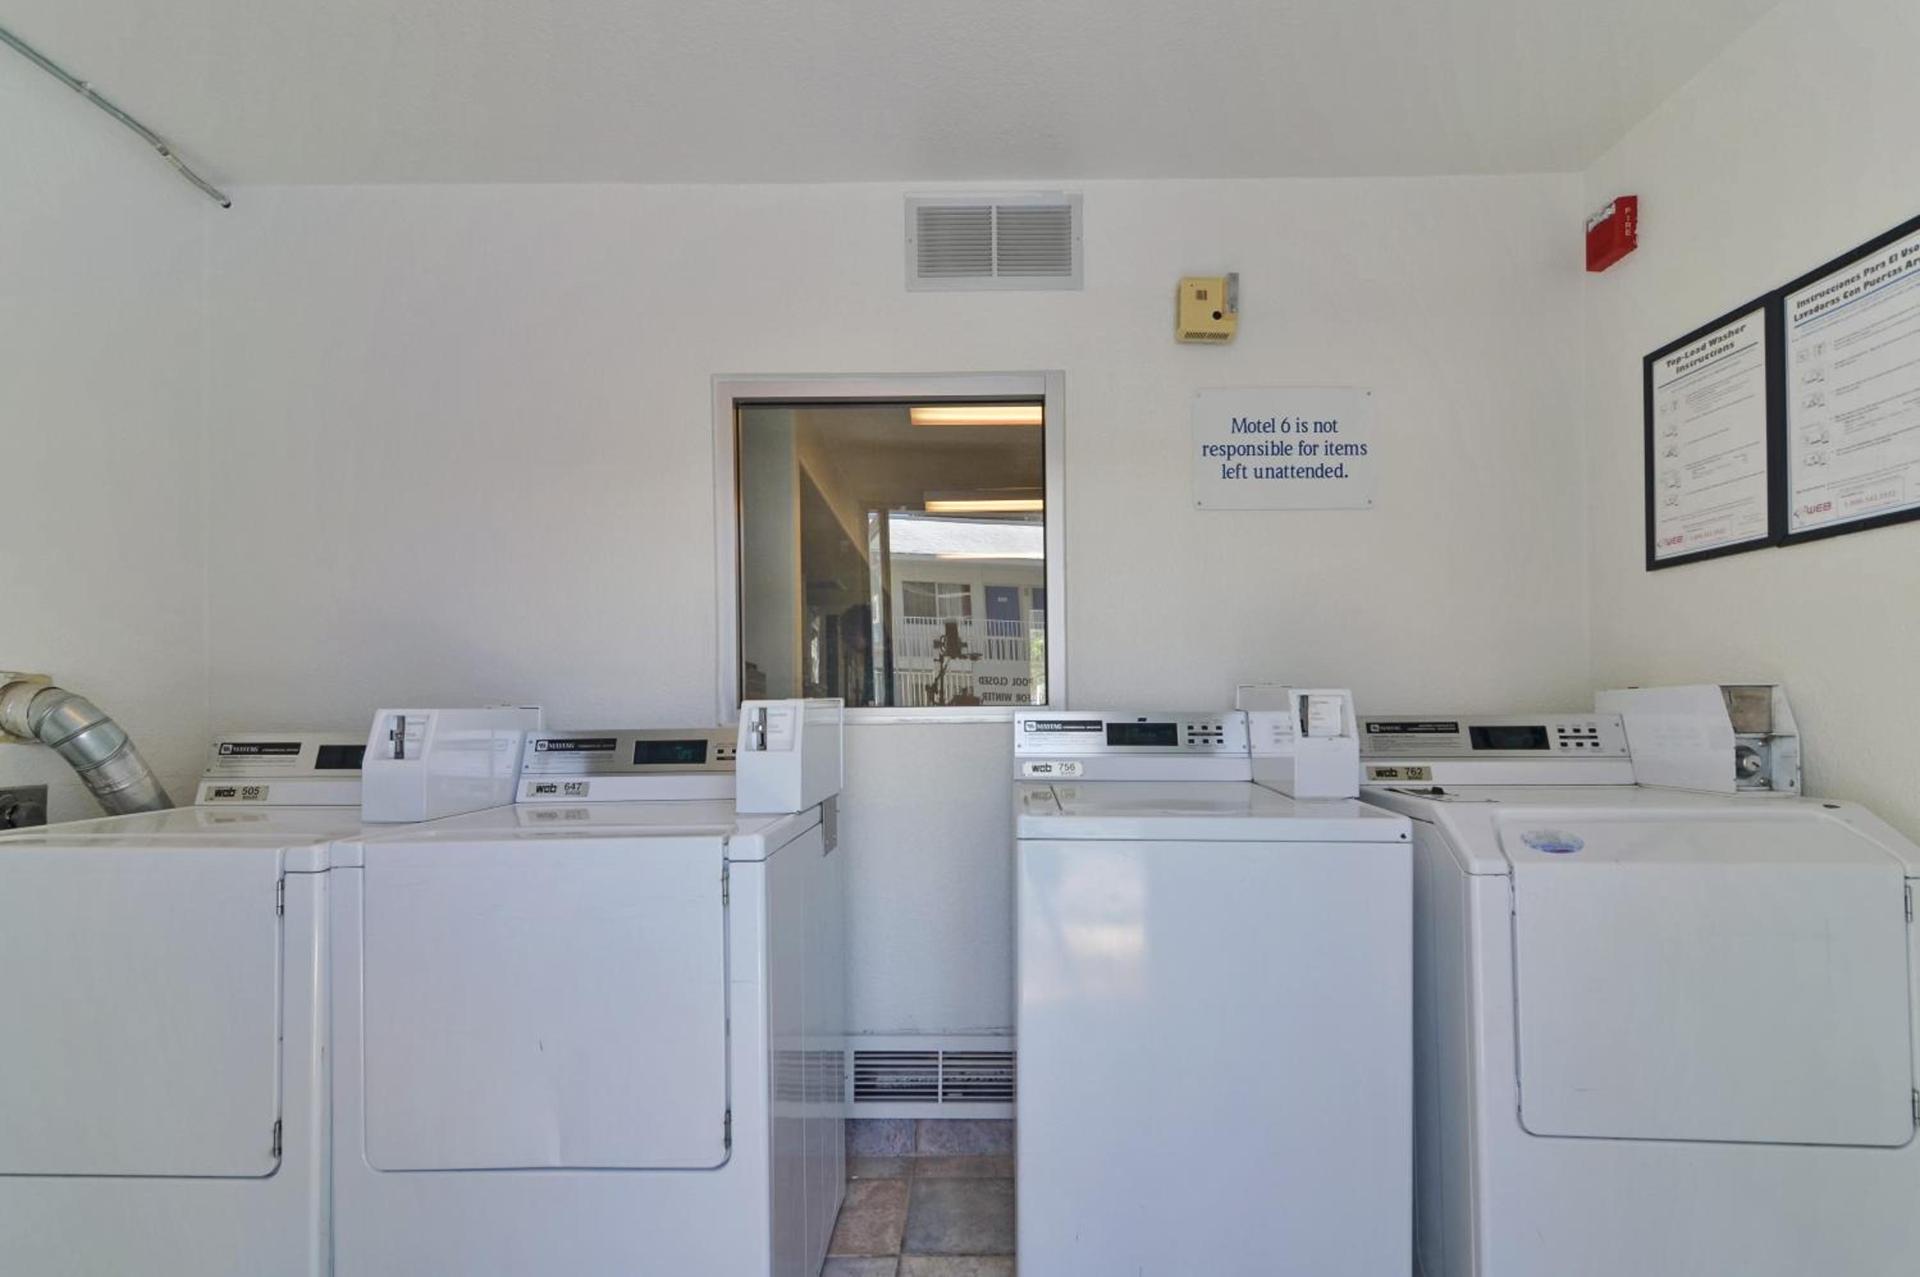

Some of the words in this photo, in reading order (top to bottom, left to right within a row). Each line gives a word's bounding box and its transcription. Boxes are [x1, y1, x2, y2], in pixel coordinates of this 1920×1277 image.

[1796, 274, 1861, 309] Instrucciones
[1863, 261, 1886, 277] Para
[1888, 253, 1898, 264] El
[1794, 296, 1840, 322] Lavadoras
[1842, 287, 1861, 299] Con
[1863, 266, 1902, 291] Puertas
[1666, 342, 1707, 368] Top-Load
[1708, 324, 1747, 347] Washer
[1676, 342, 1735, 375] Instructions
[1231, 417, 1275, 434] Motel
[1280, 417, 1291, 434] 6
[1296, 417, 1309, 434] is
[1313, 419, 1339, 434] not
[1202, 440, 1293, 461] responsible
[1298, 440, 1319, 456] for
[1324, 440, 1368, 456] items
[1221, 463, 1248, 479] left
[1253, 463, 1349, 479] unattended.
[1404, 767, 1423, 776] 762
[241, 786, 261, 796] 505
[564, 782, 582, 791] 647
